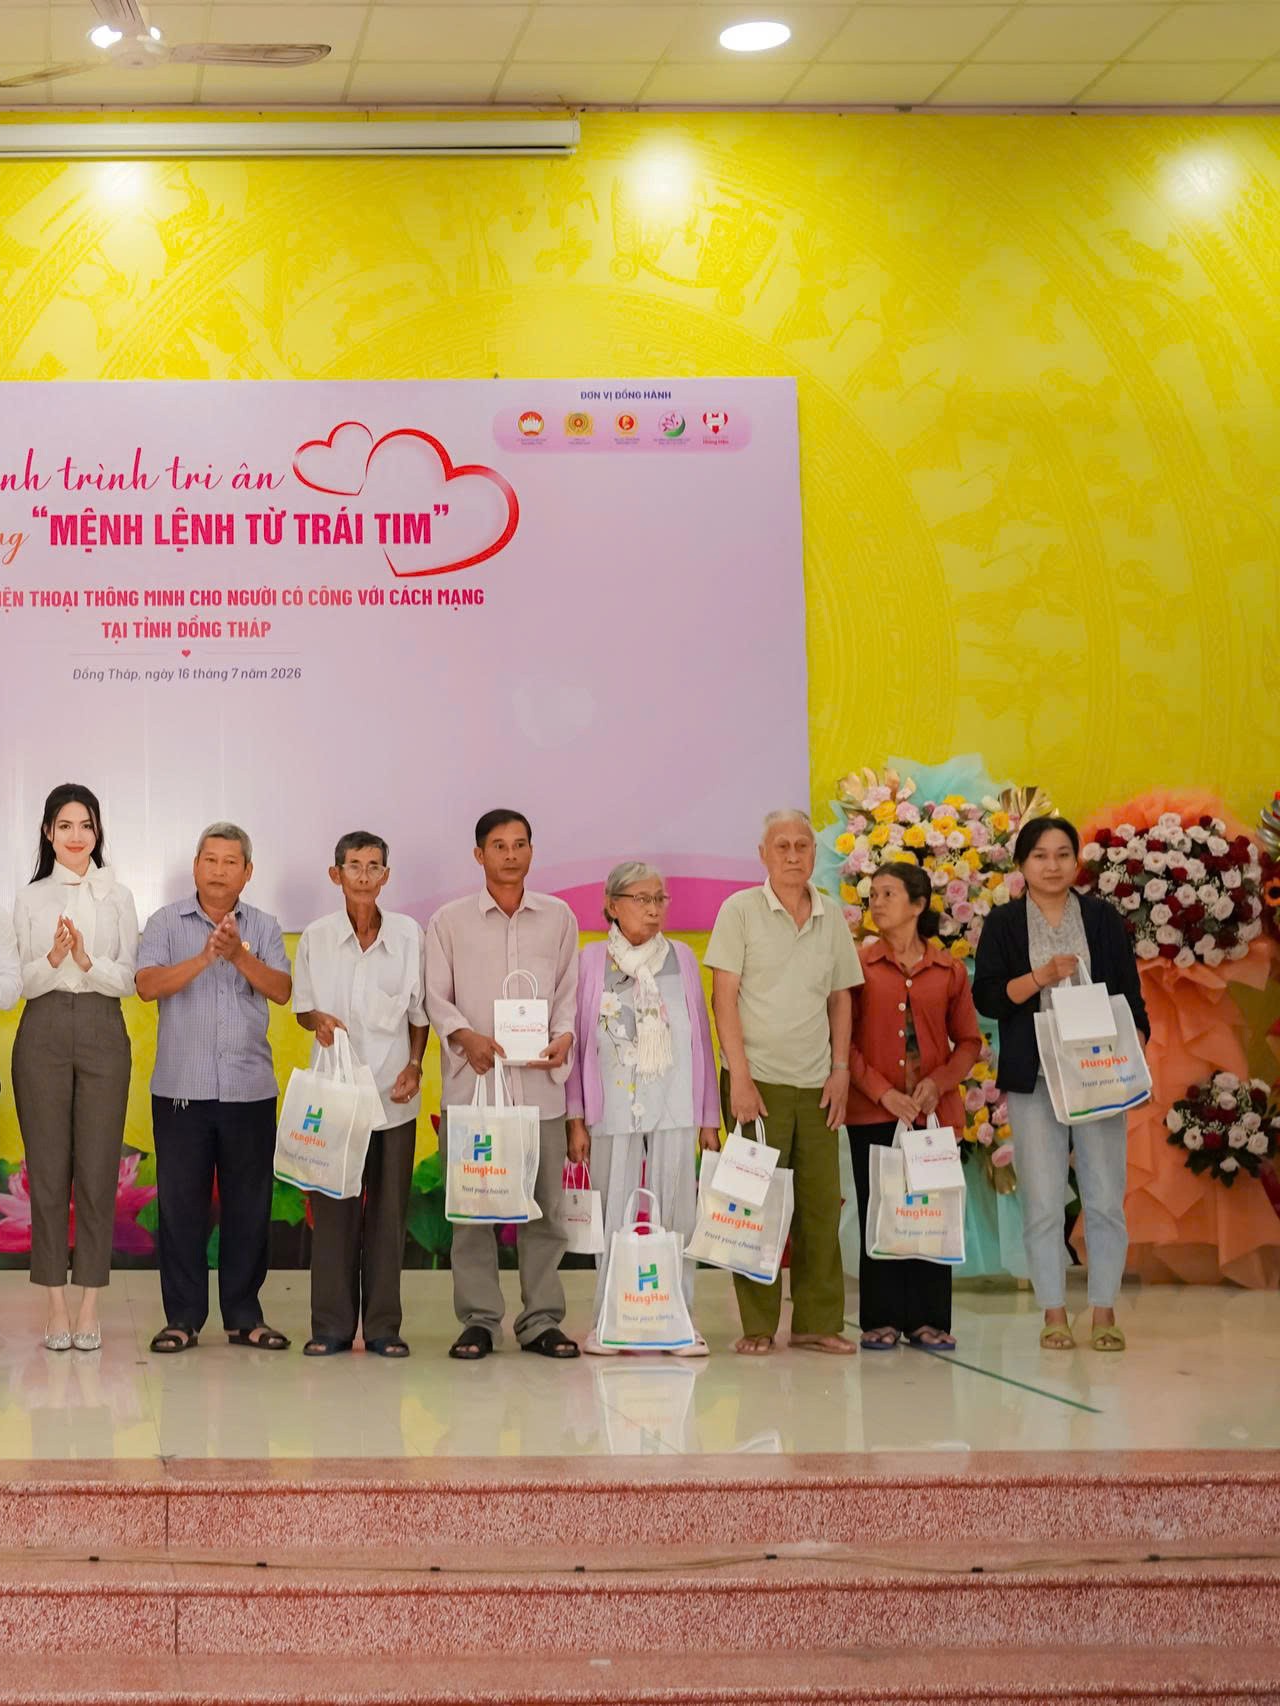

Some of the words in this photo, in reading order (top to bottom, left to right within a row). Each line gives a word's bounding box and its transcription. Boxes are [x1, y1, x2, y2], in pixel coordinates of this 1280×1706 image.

[603, 391, 613, 402] VỊ
[57, 447, 159, 491] trình
[165, 456, 224, 490] tri
[231, 462, 286, 490] ân
[154, 506, 235, 553] LỆNH
[245, 505, 287, 545] TỪ
[293, 505, 363, 545] TRÁI
[29, 590, 79, 613] THOẠI
[84, 586, 139, 607] THÔNG
[143, 590, 185, 607] MINH
[189, 589, 222, 606] CHO
[227, 585, 277, 606] NGƯỜI
[282, 585, 303, 606] CÓ
[308, 585, 353, 606] CÔNG
[357, 585, 385, 606] VỚI
[389, 585, 433, 606] CÁCH
[437, 589, 485, 611] MẠNG
[102, 621, 128, 644] TẠI
[133, 616, 172, 639] TỈNH
[177, 614, 222, 638] ĐỒNG
[227, 617, 272, 638] THÁP
[72, 666, 104, 682] Đồng
[108, 668, 141, 682] Tháp,
[145, 669, 175, 682] ngày
[178, 668, 190, 680] 16
[193, 667, 228, 682] tháng
[231, 668, 239, 680] 7
[241, 667, 268, 680] năm
[270, 668, 302, 680] 2026
[463, 1164, 507, 1178] HungHau
[711, 1211, 764, 1232] HungHau
